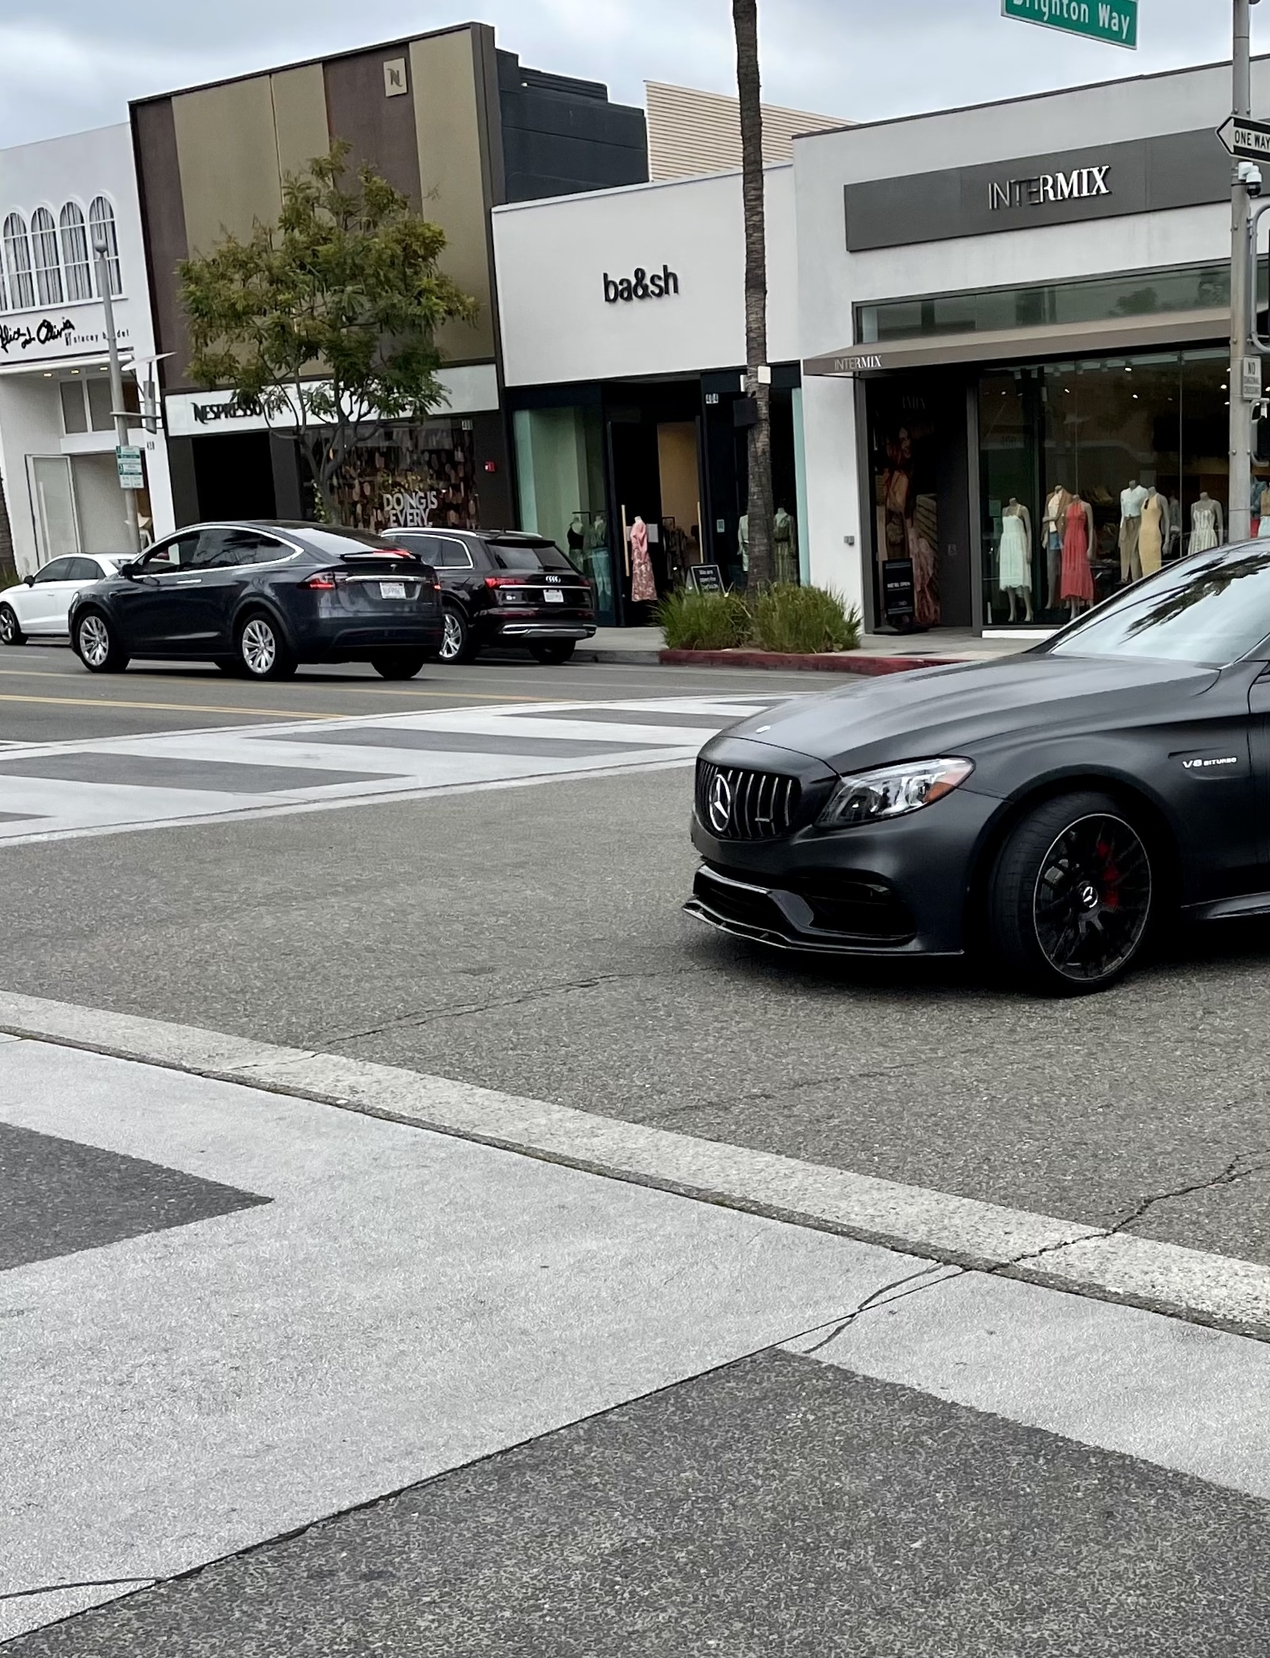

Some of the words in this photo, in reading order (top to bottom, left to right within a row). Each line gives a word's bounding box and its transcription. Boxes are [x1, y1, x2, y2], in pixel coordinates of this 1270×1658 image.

[1099, 3, 1130, 39] Way
[1234, 130, 1252, 146] ONE
[1254, 133, 1270, 150] WAY
[988, 165, 1110, 210] INTERMIX
[603, 264, 679, 303] ba&sh
[834, 355, 882, 370] INTERMIX
[1182, 759, 1202, 768] V8
[1203, 757, 1237, 766] BITURBO
